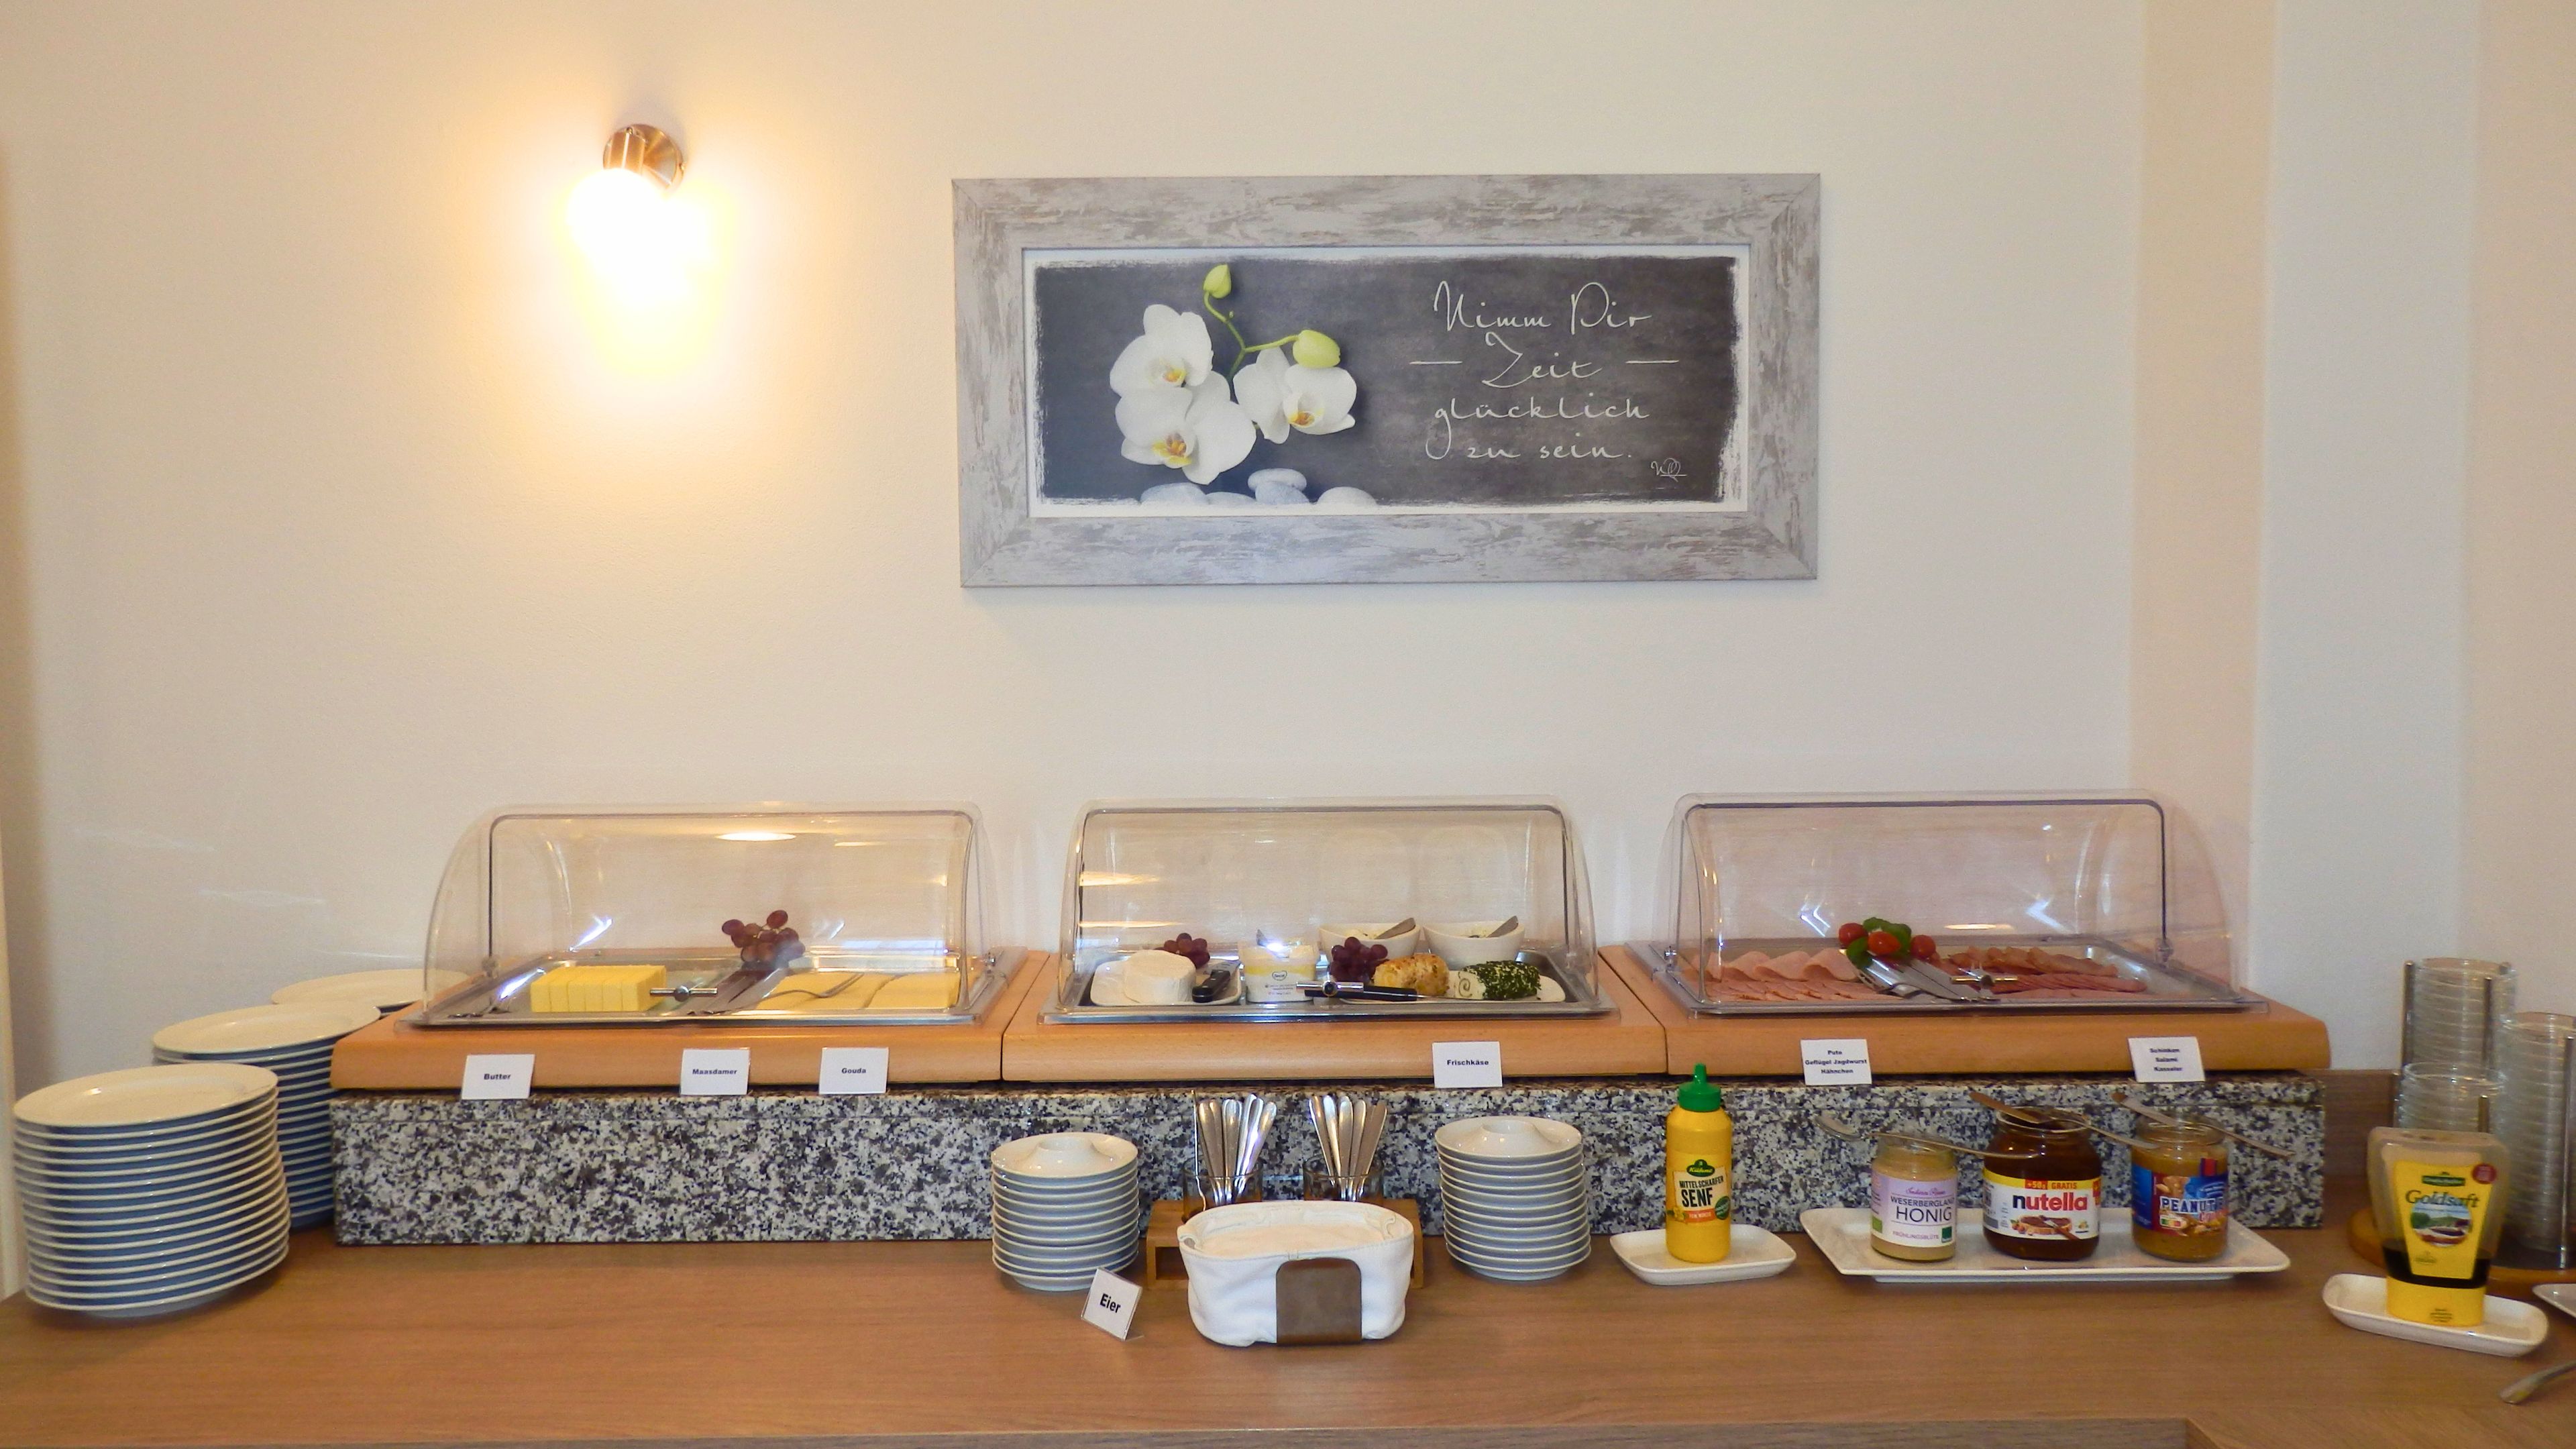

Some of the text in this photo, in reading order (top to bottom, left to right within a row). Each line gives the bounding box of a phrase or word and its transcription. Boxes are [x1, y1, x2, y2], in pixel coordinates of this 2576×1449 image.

[1433, 280, 1551, 331] Nimm
[1481, 331, 1603, 388] Zeit
[1425, 392, 1650, 460] glücklich
[1466, 431, 1633, 459] zu sein.
[2051, 1181, 2078, 1189] GRATIS
[1681, 1187, 1713, 1208] SENF
[2012, 1191, 2088, 1212] nutella
[1896, 1205, 1952, 1222] HONIG
[1099, 1292, 1121, 1313] Eier
